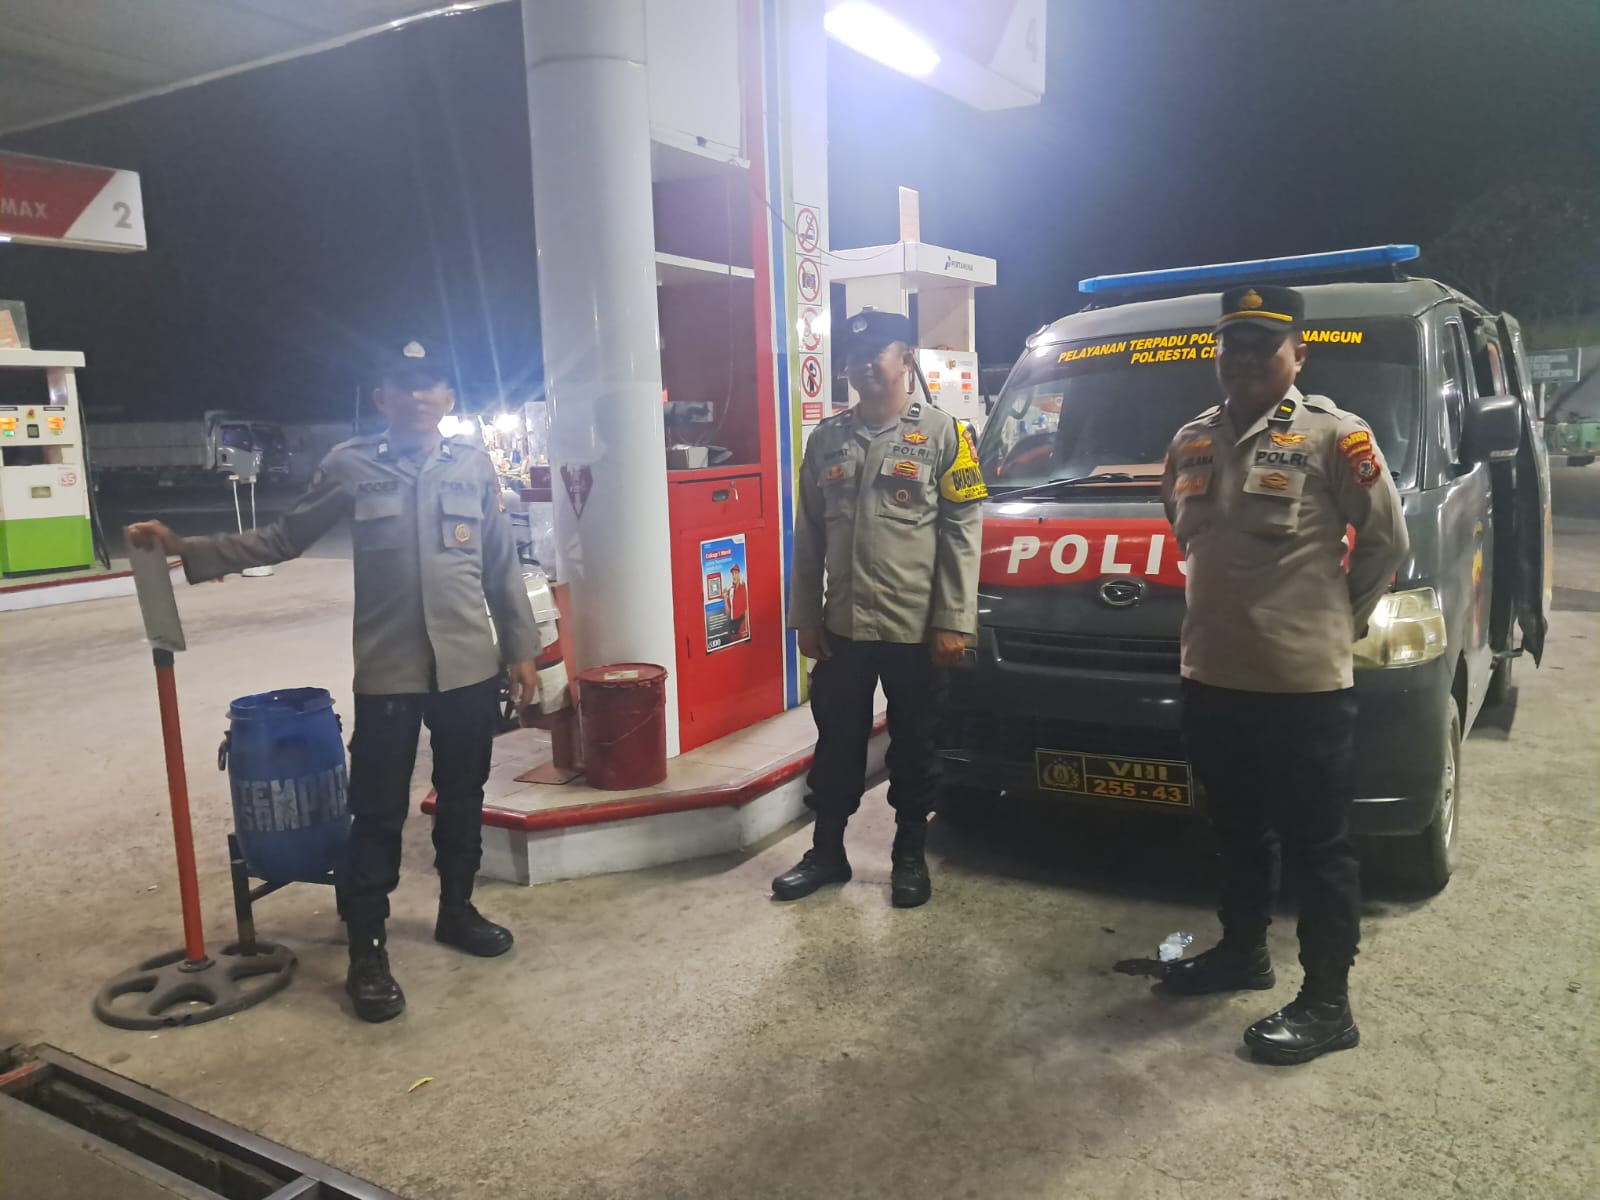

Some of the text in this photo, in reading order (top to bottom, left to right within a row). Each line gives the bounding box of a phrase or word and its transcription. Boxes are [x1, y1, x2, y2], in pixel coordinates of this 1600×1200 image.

[112, 201, 133, 229] 2
[1057, 341, 1127, 364] PELAYANAN
[1129, 334, 1187, 351] TERPADU
[1189, 332, 1218, 345] POL
[1130, 347, 1216, 365] POLRESTA CI
[893, 445, 930, 458] POLRI
[1255, 451, 1309, 467] POLRI
[1007, 534, 1188, 575] POLI
